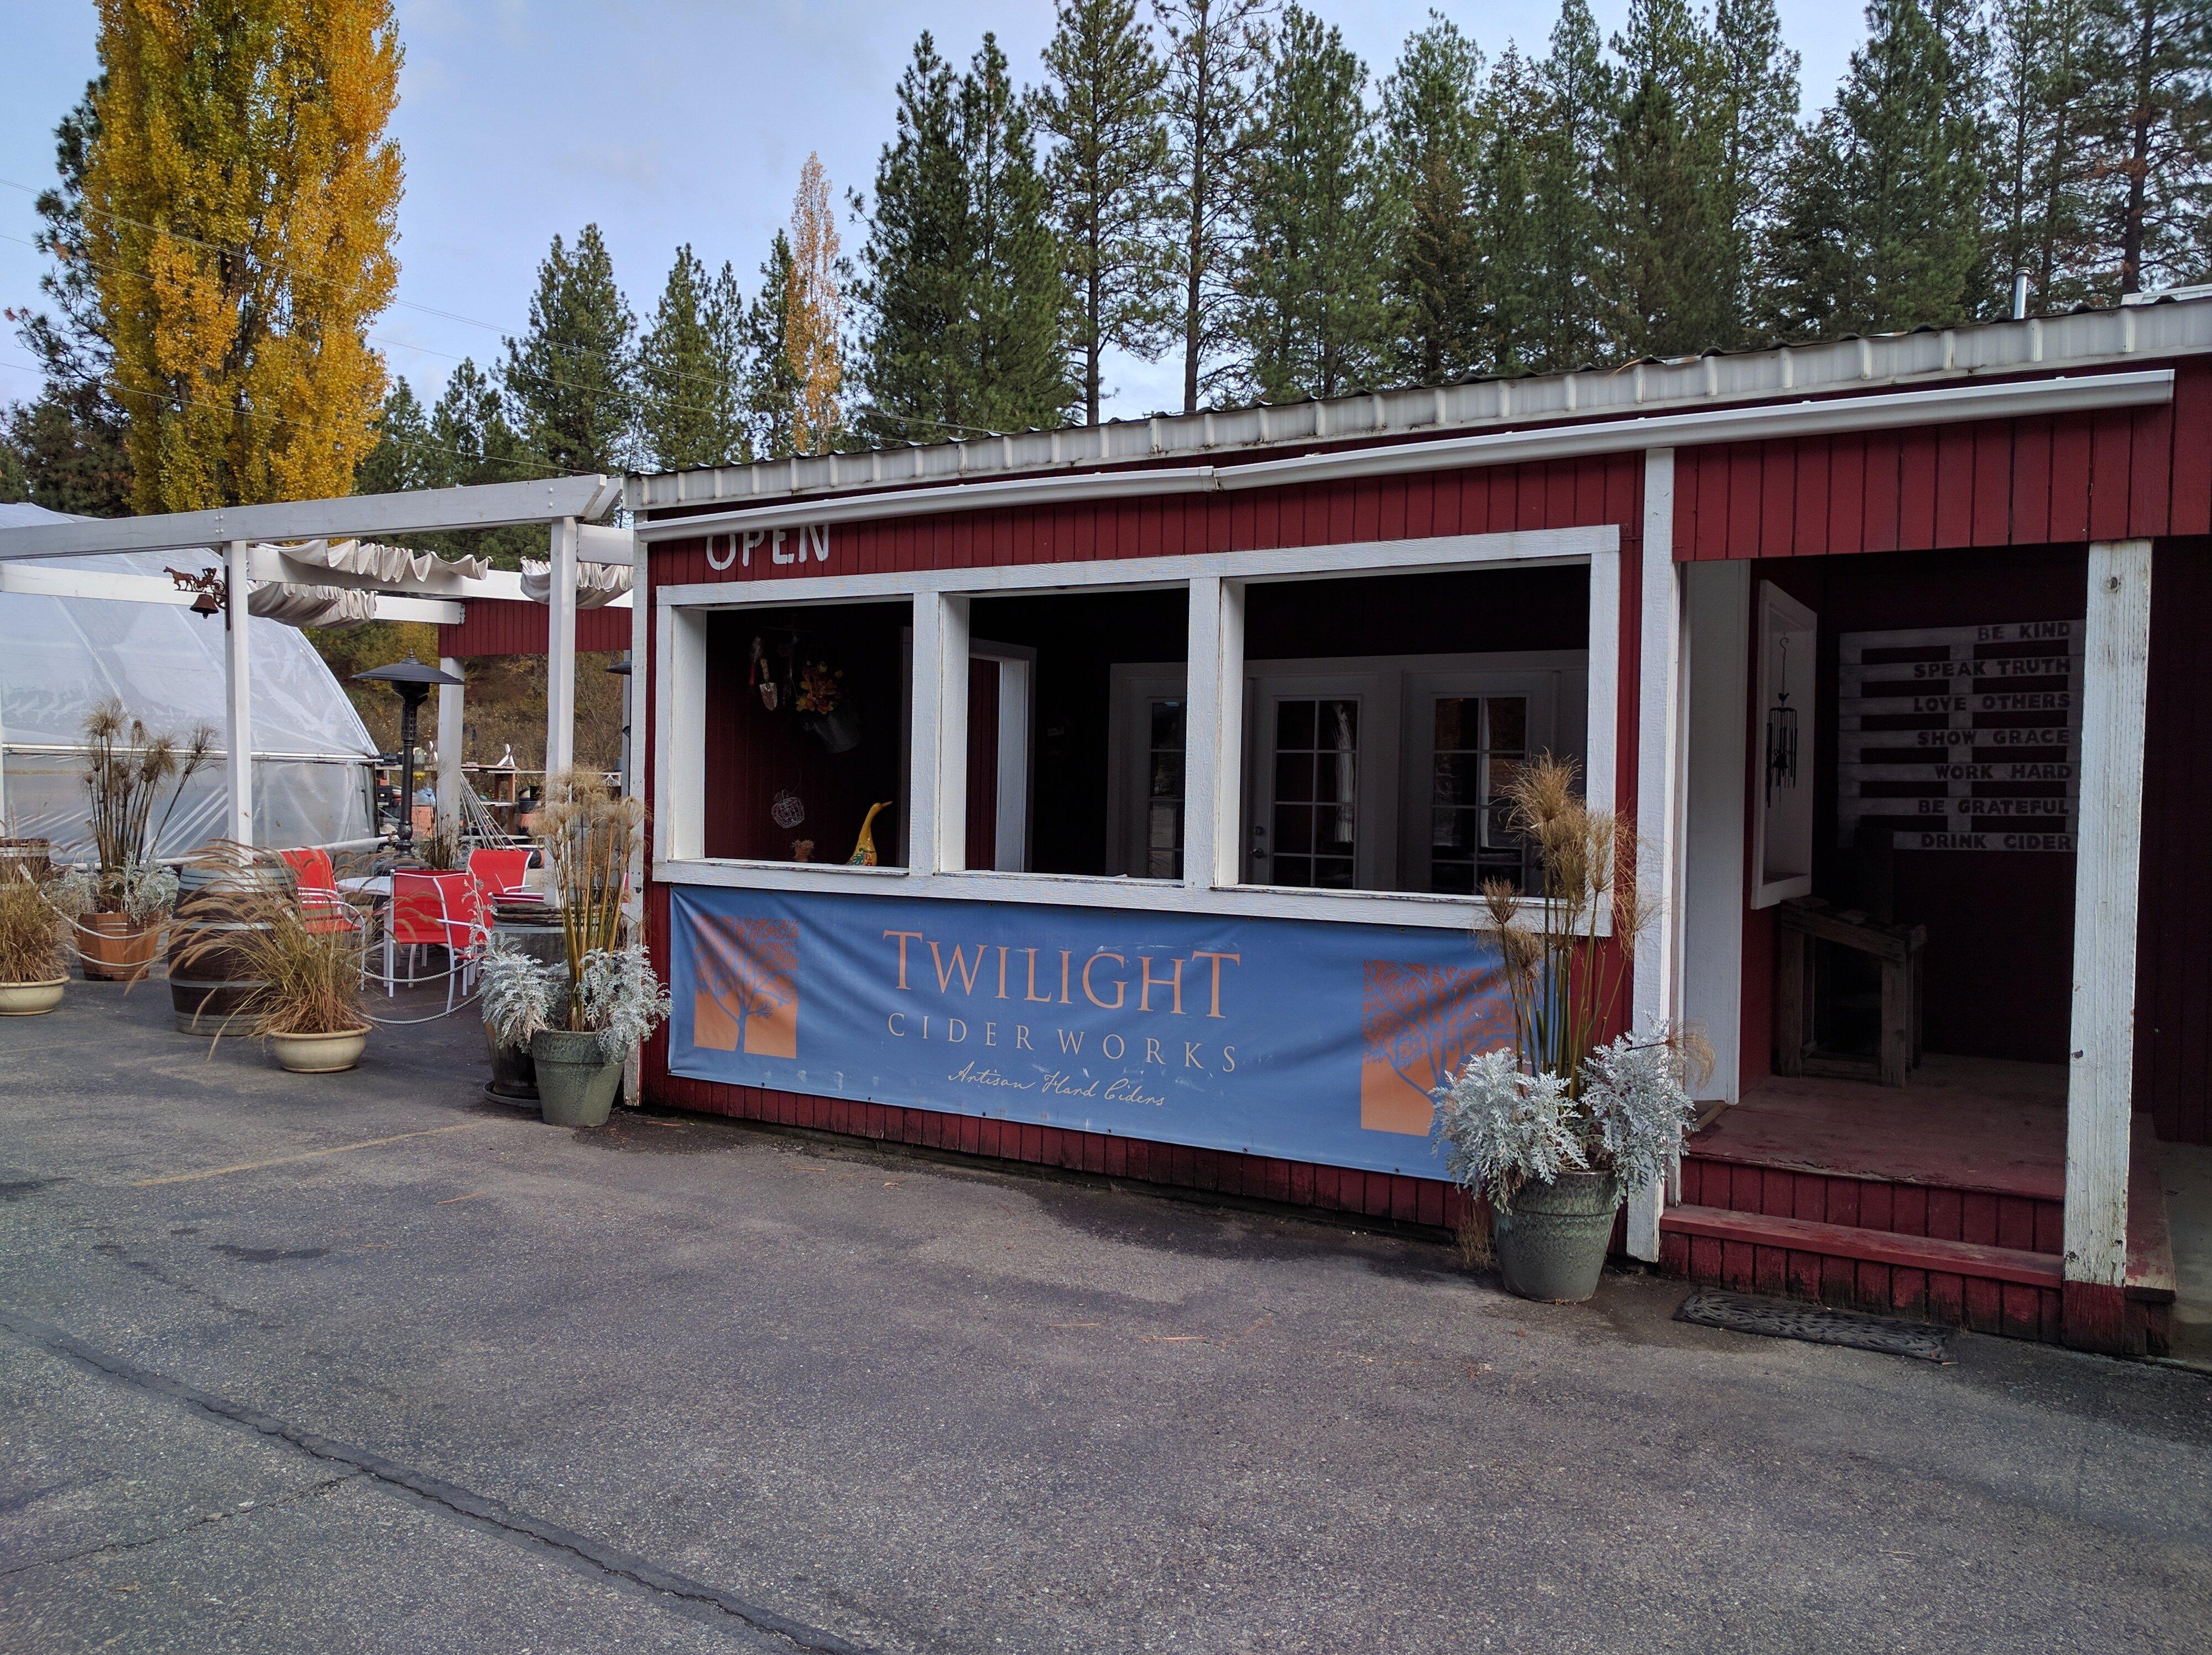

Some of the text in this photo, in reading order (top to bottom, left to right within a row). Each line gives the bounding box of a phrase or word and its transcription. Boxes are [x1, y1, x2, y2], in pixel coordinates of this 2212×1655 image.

[706, 523, 829, 570] OPEN
[1978, 622, 2071, 642] BE KIND
[1913, 658, 2070, 679] SPEAK TRUTH
[1913, 693, 2071, 712] LOVE OTHERS
[1917, 729, 2070, 745] SHOW GRACE
[1934, 764, 2073, 779] WORK HARD
[1918, 800, 2069, 814] BE GRATEFUL
[1921, 834, 2072, 850] DRINK CIDER
[883, 930, 1240, 1018] TWILIGHT
[948, 1060, 1165, 1106] Artisan Hard Ciders
